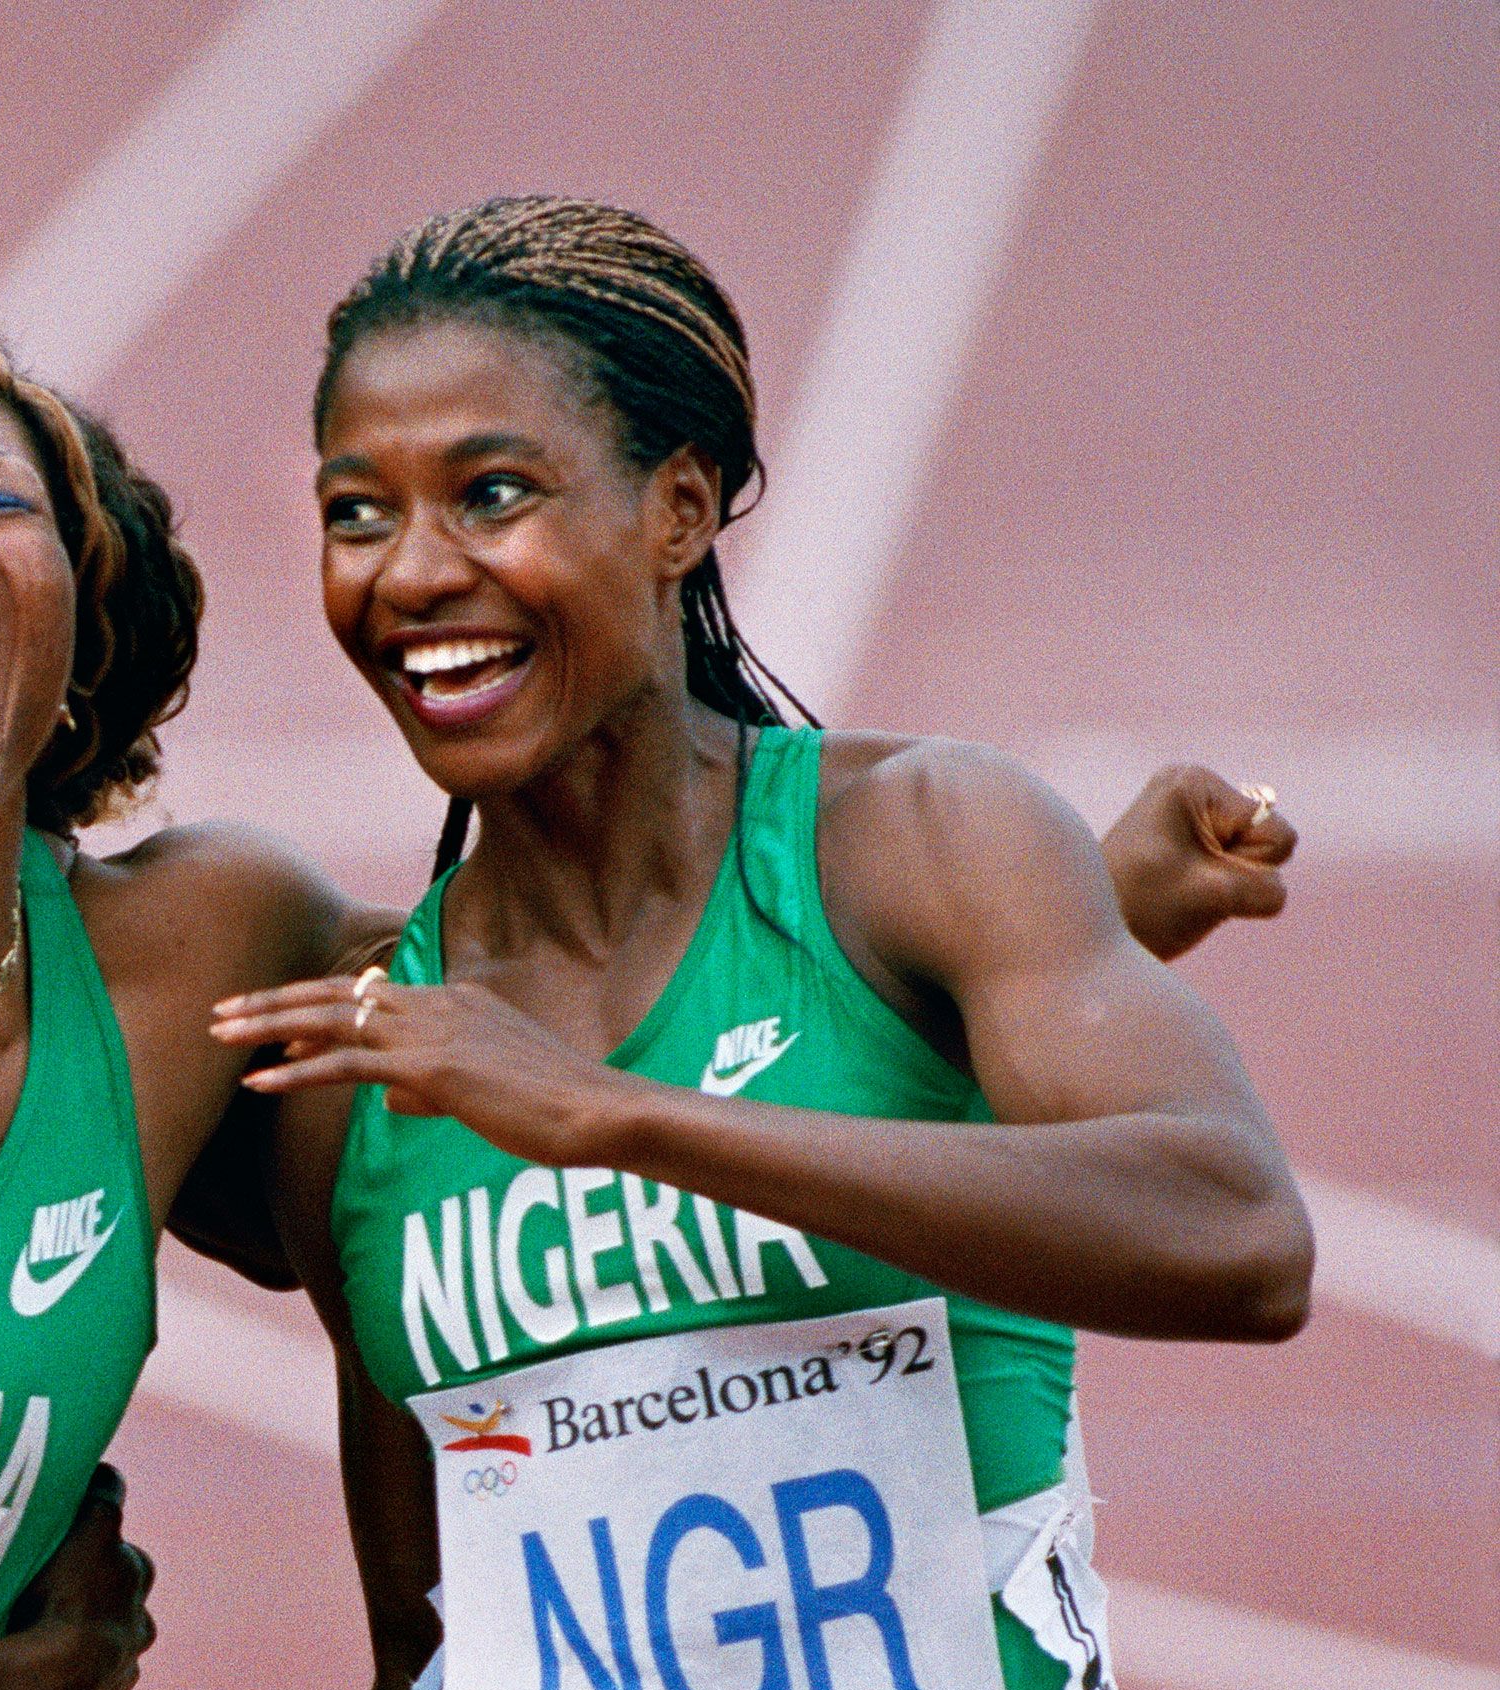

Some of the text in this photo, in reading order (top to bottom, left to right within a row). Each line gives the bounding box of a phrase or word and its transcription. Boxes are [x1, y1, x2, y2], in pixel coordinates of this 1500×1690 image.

[713, 1016, 781, 1072] NIKE
[29, 1187, 105, 1264] NIKE
[402, 1166, 829, 1386] NIGERIA
